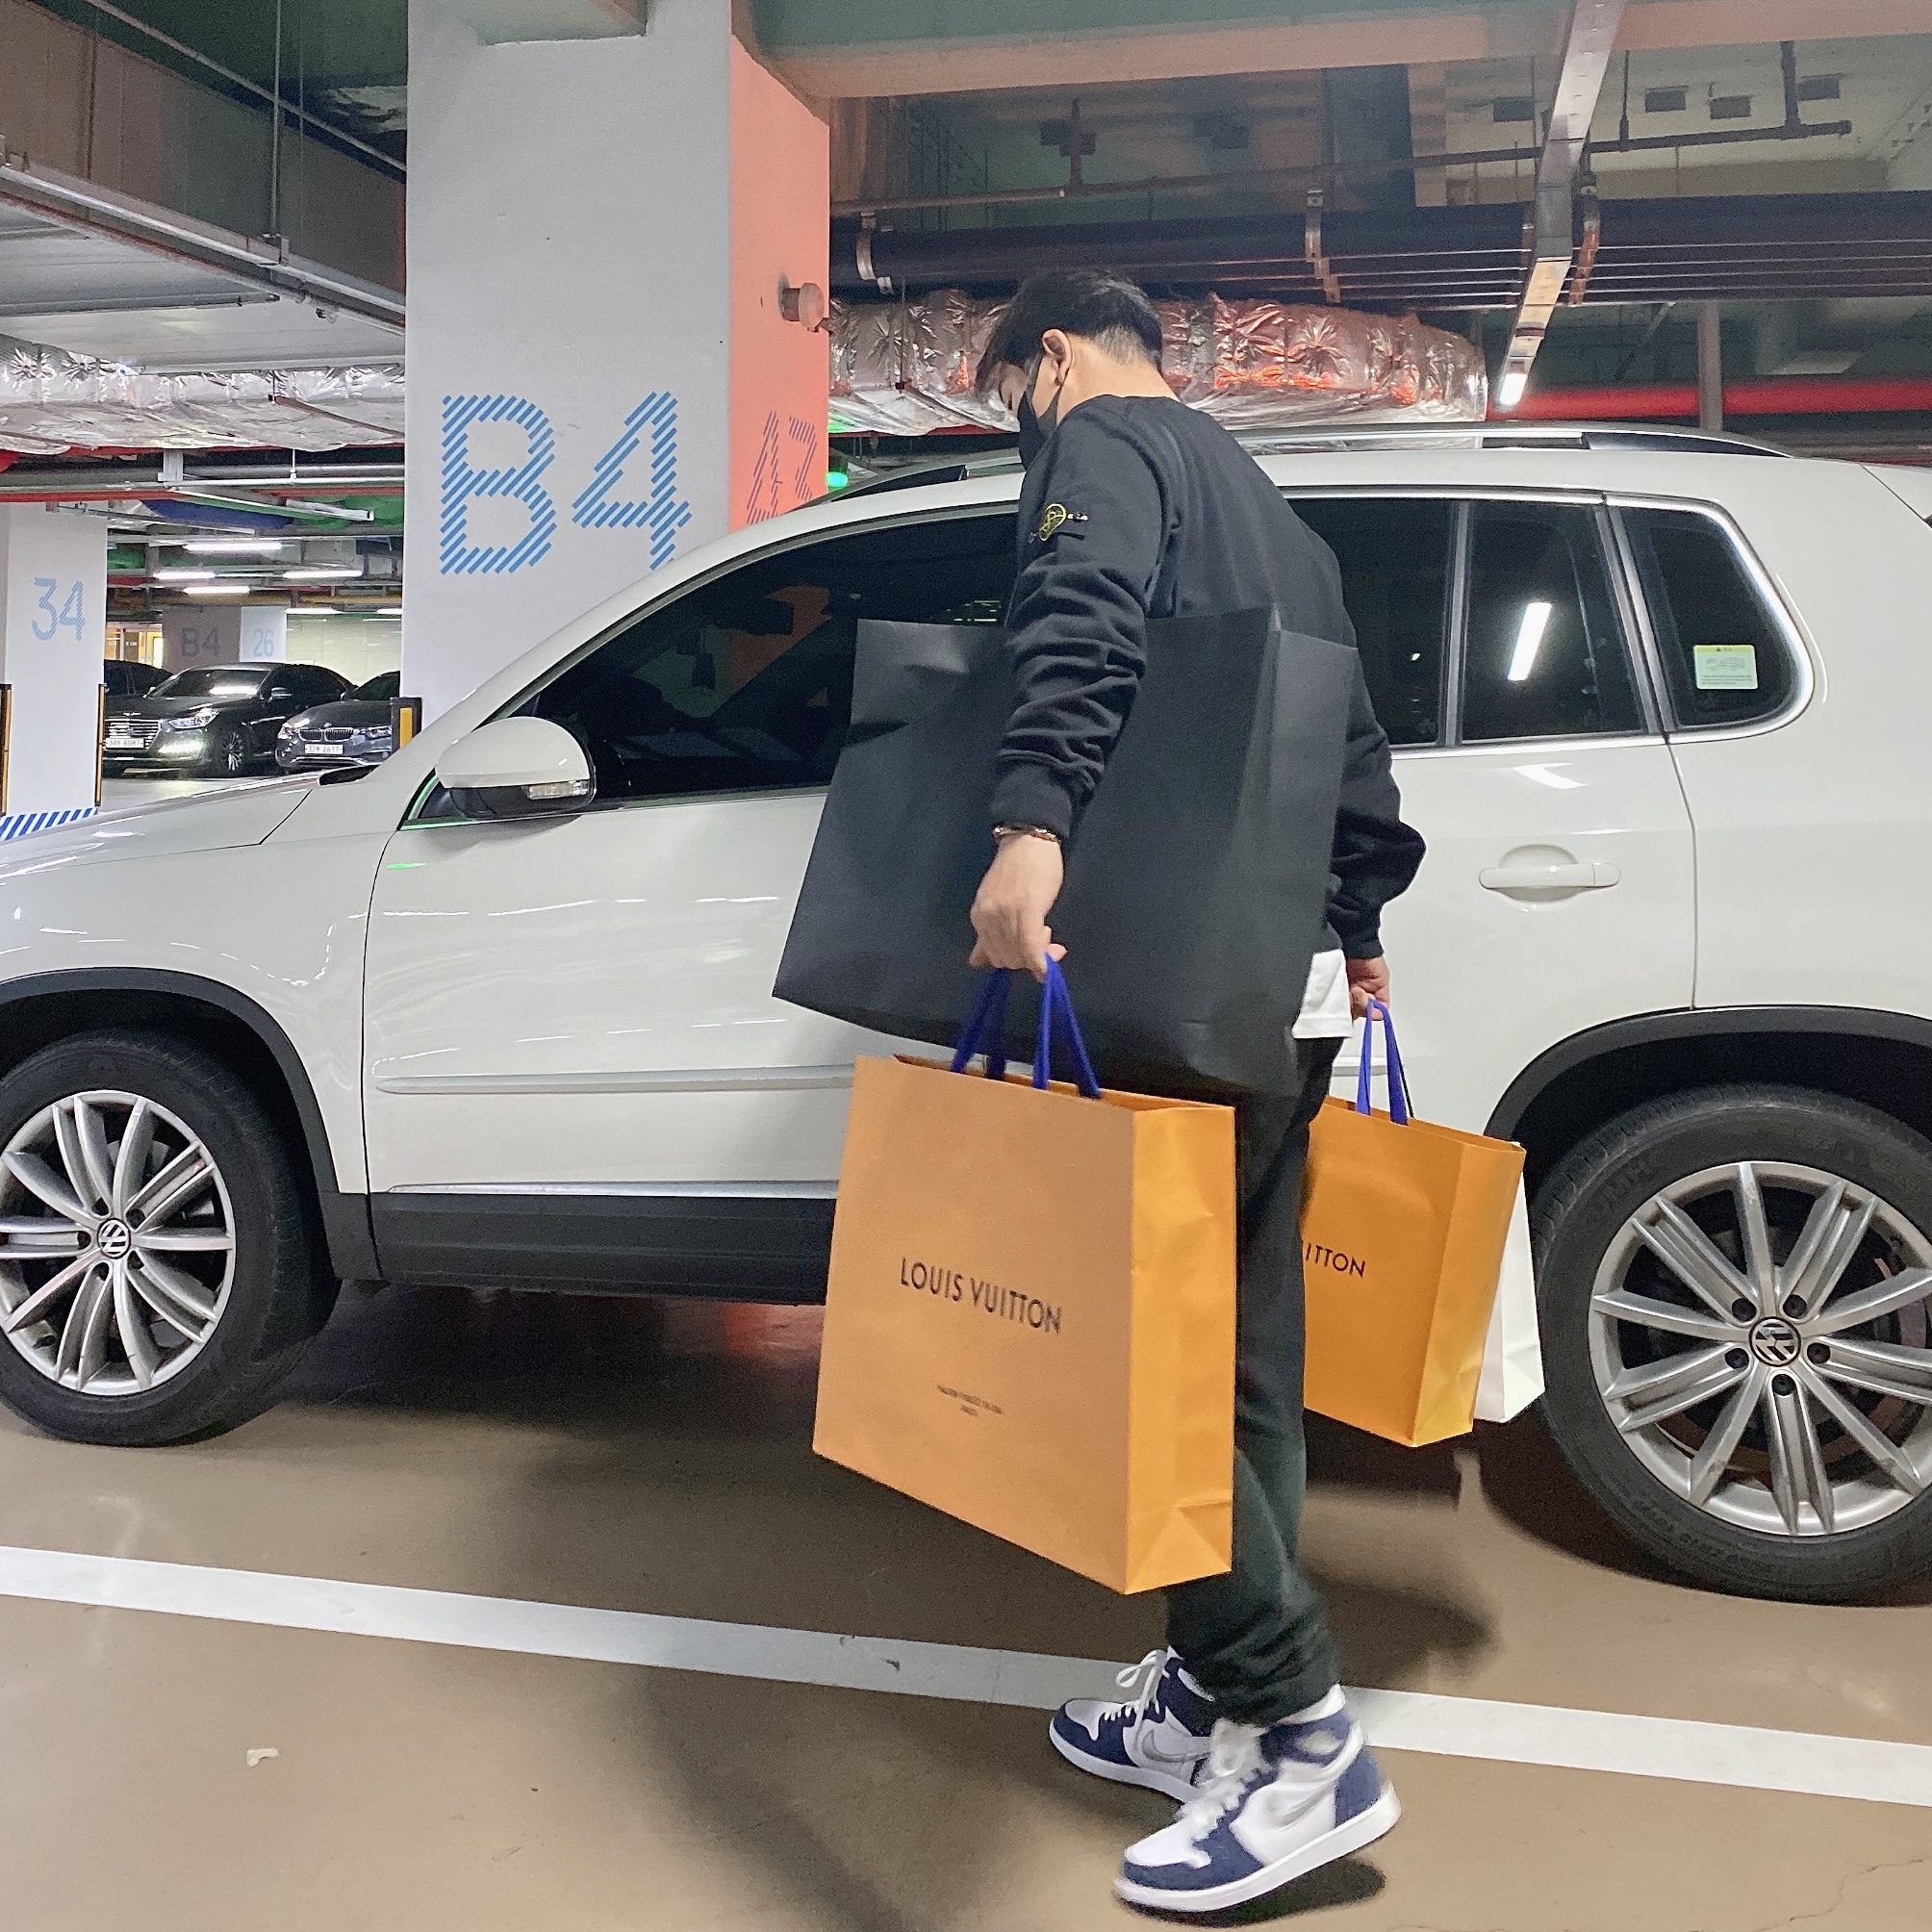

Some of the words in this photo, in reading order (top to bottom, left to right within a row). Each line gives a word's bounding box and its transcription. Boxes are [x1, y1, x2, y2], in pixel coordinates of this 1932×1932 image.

[440, 391, 693, 574] B4
[31, 576, 87, 642] 34
[181, 624, 221, 657] B4
[252, 627, 275, 657] 26
[1305, 1241, 1366, 1279] ITTON
[900, 1257, 963, 1303] LOUIS
[969, 1277, 1063, 1335] VUITTON
